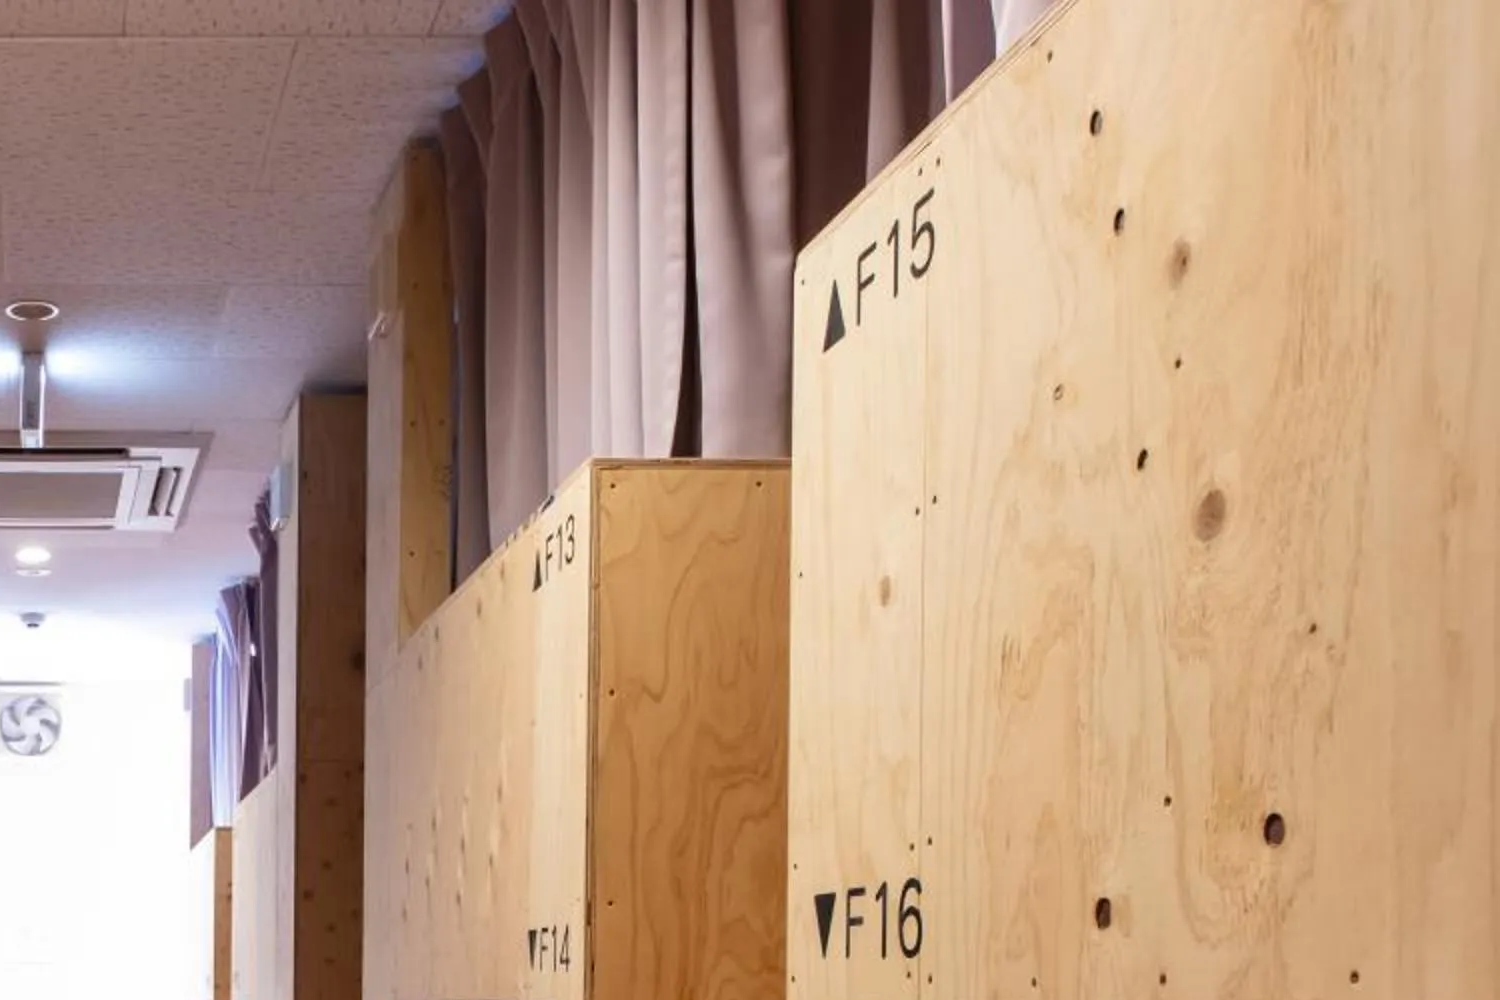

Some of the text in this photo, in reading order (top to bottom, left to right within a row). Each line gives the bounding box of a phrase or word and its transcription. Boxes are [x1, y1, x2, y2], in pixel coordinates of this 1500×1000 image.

[856, 186, 936, 327] F15
[545, 513, 575, 582] F13
[540, 923, 571, 973] F14
[845, 877, 923, 960] F16
